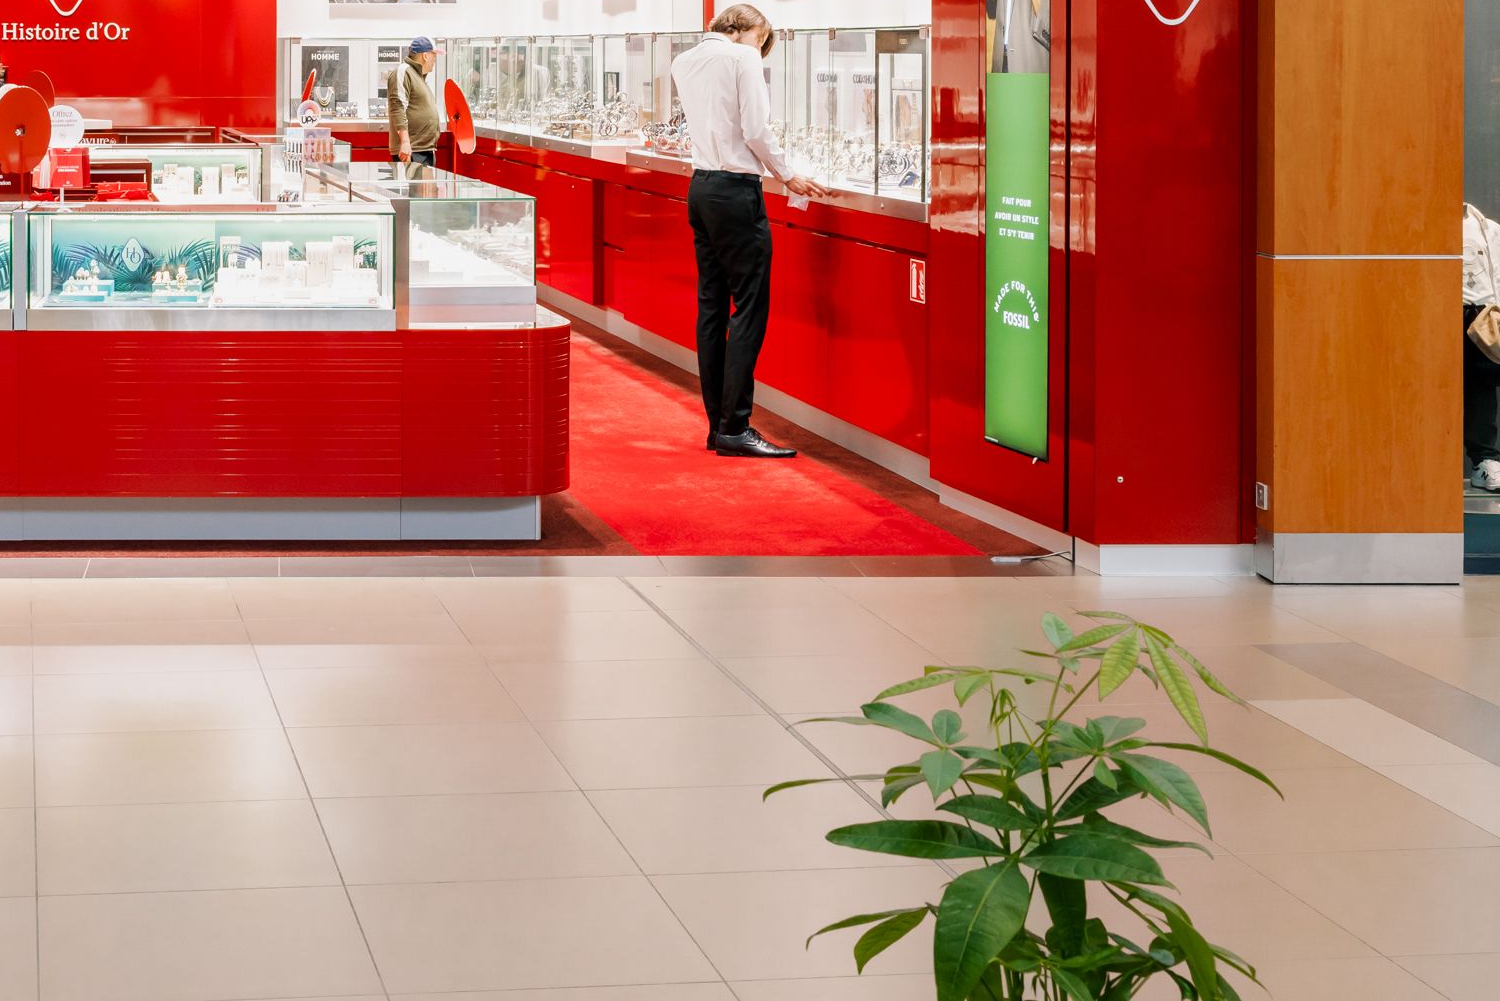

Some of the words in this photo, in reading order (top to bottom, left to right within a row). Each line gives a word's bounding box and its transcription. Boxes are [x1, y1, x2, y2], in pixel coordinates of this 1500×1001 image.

[1, 22, 80, 41] Histoire
[86, 21, 131, 41] d'Or
[311, 53, 340, 61] HOMME
[80, 137, 110, 145] avure
[1002, 196, 1015, 205] FAIT
[1015, 198, 1032, 208] POUR
[994, 211, 1012, 220] AVOIR
[1012, 213, 1021, 222] UN
[1021, 215, 1039, 225] STYLE
[999, 227, 1006, 236] ET
[1017, 230, 1035, 240] TENIR
[994, 282, 1010, 313] MADE
[1011, 280, 1026, 294] FOR
[1003, 310, 1030, 330] FOSSIL
